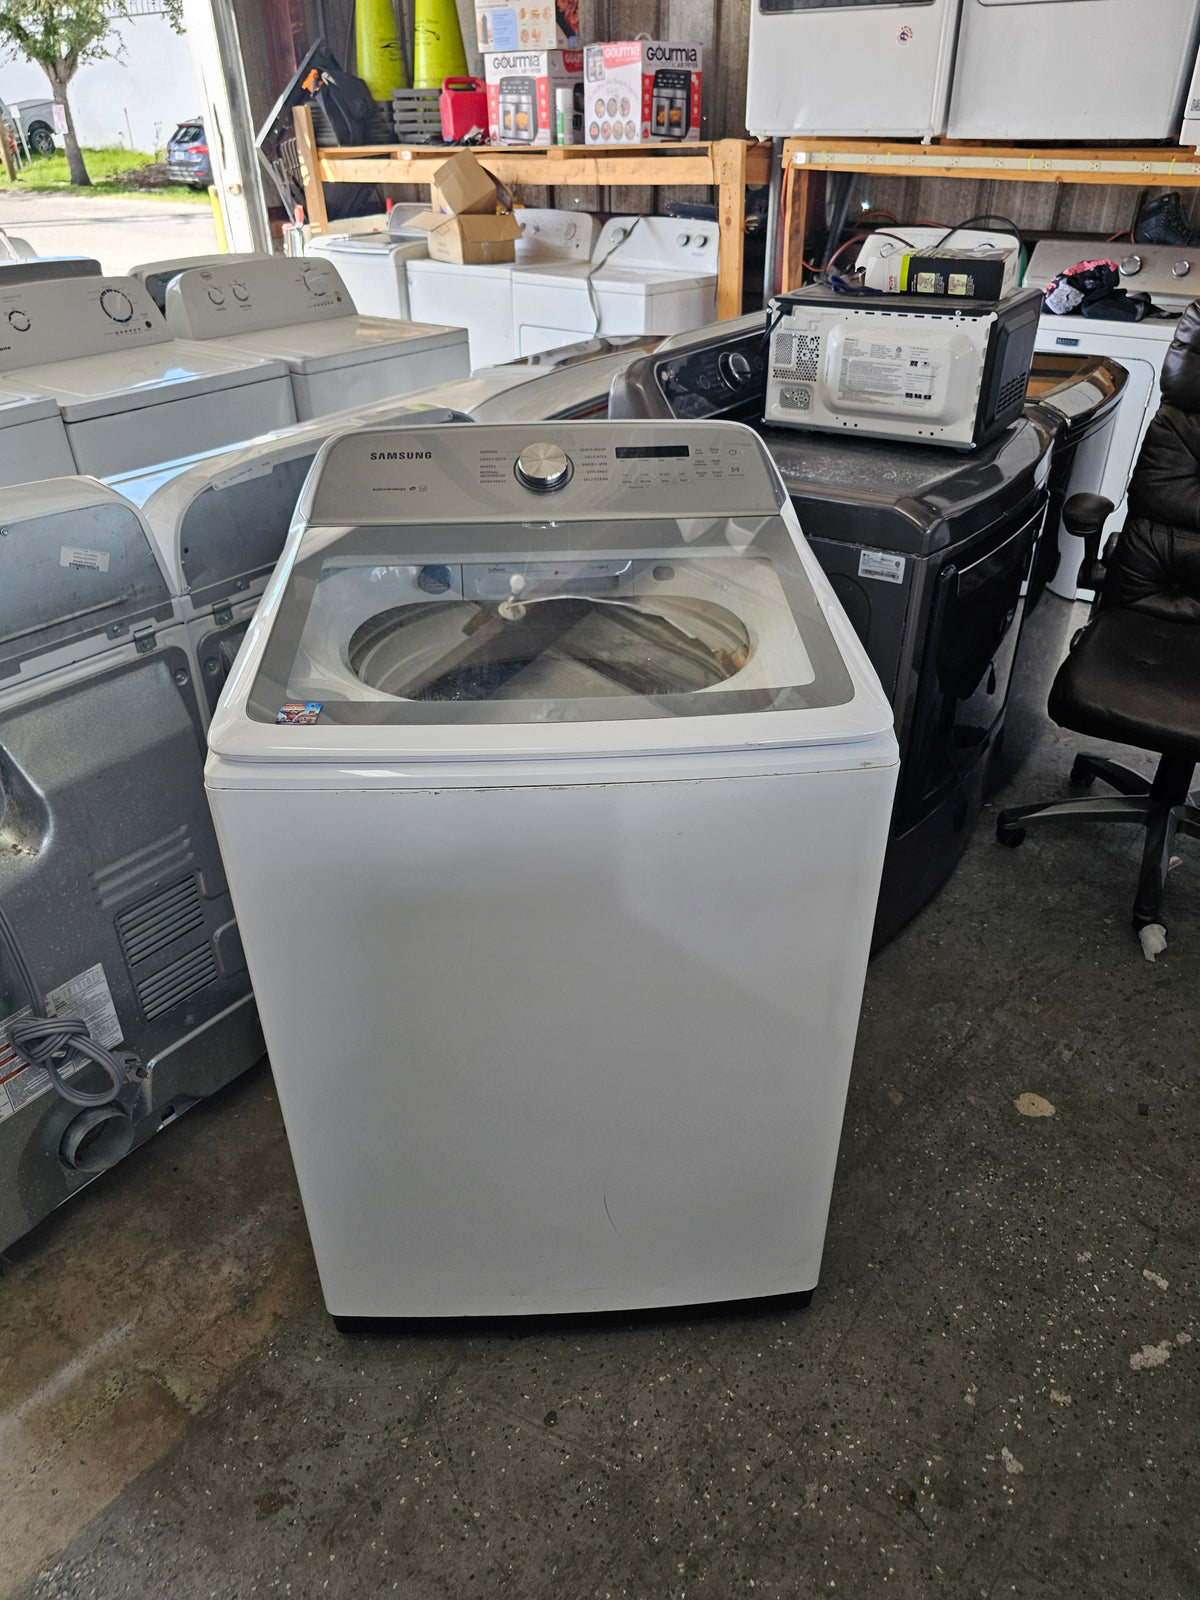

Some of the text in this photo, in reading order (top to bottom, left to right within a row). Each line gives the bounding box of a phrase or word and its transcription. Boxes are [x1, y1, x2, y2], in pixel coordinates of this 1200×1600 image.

[646, 45, 697, 61] Gourmia
[493, 54, 540, 69] Gourmia
[370, 451, 432, 460] SAMSUNG
